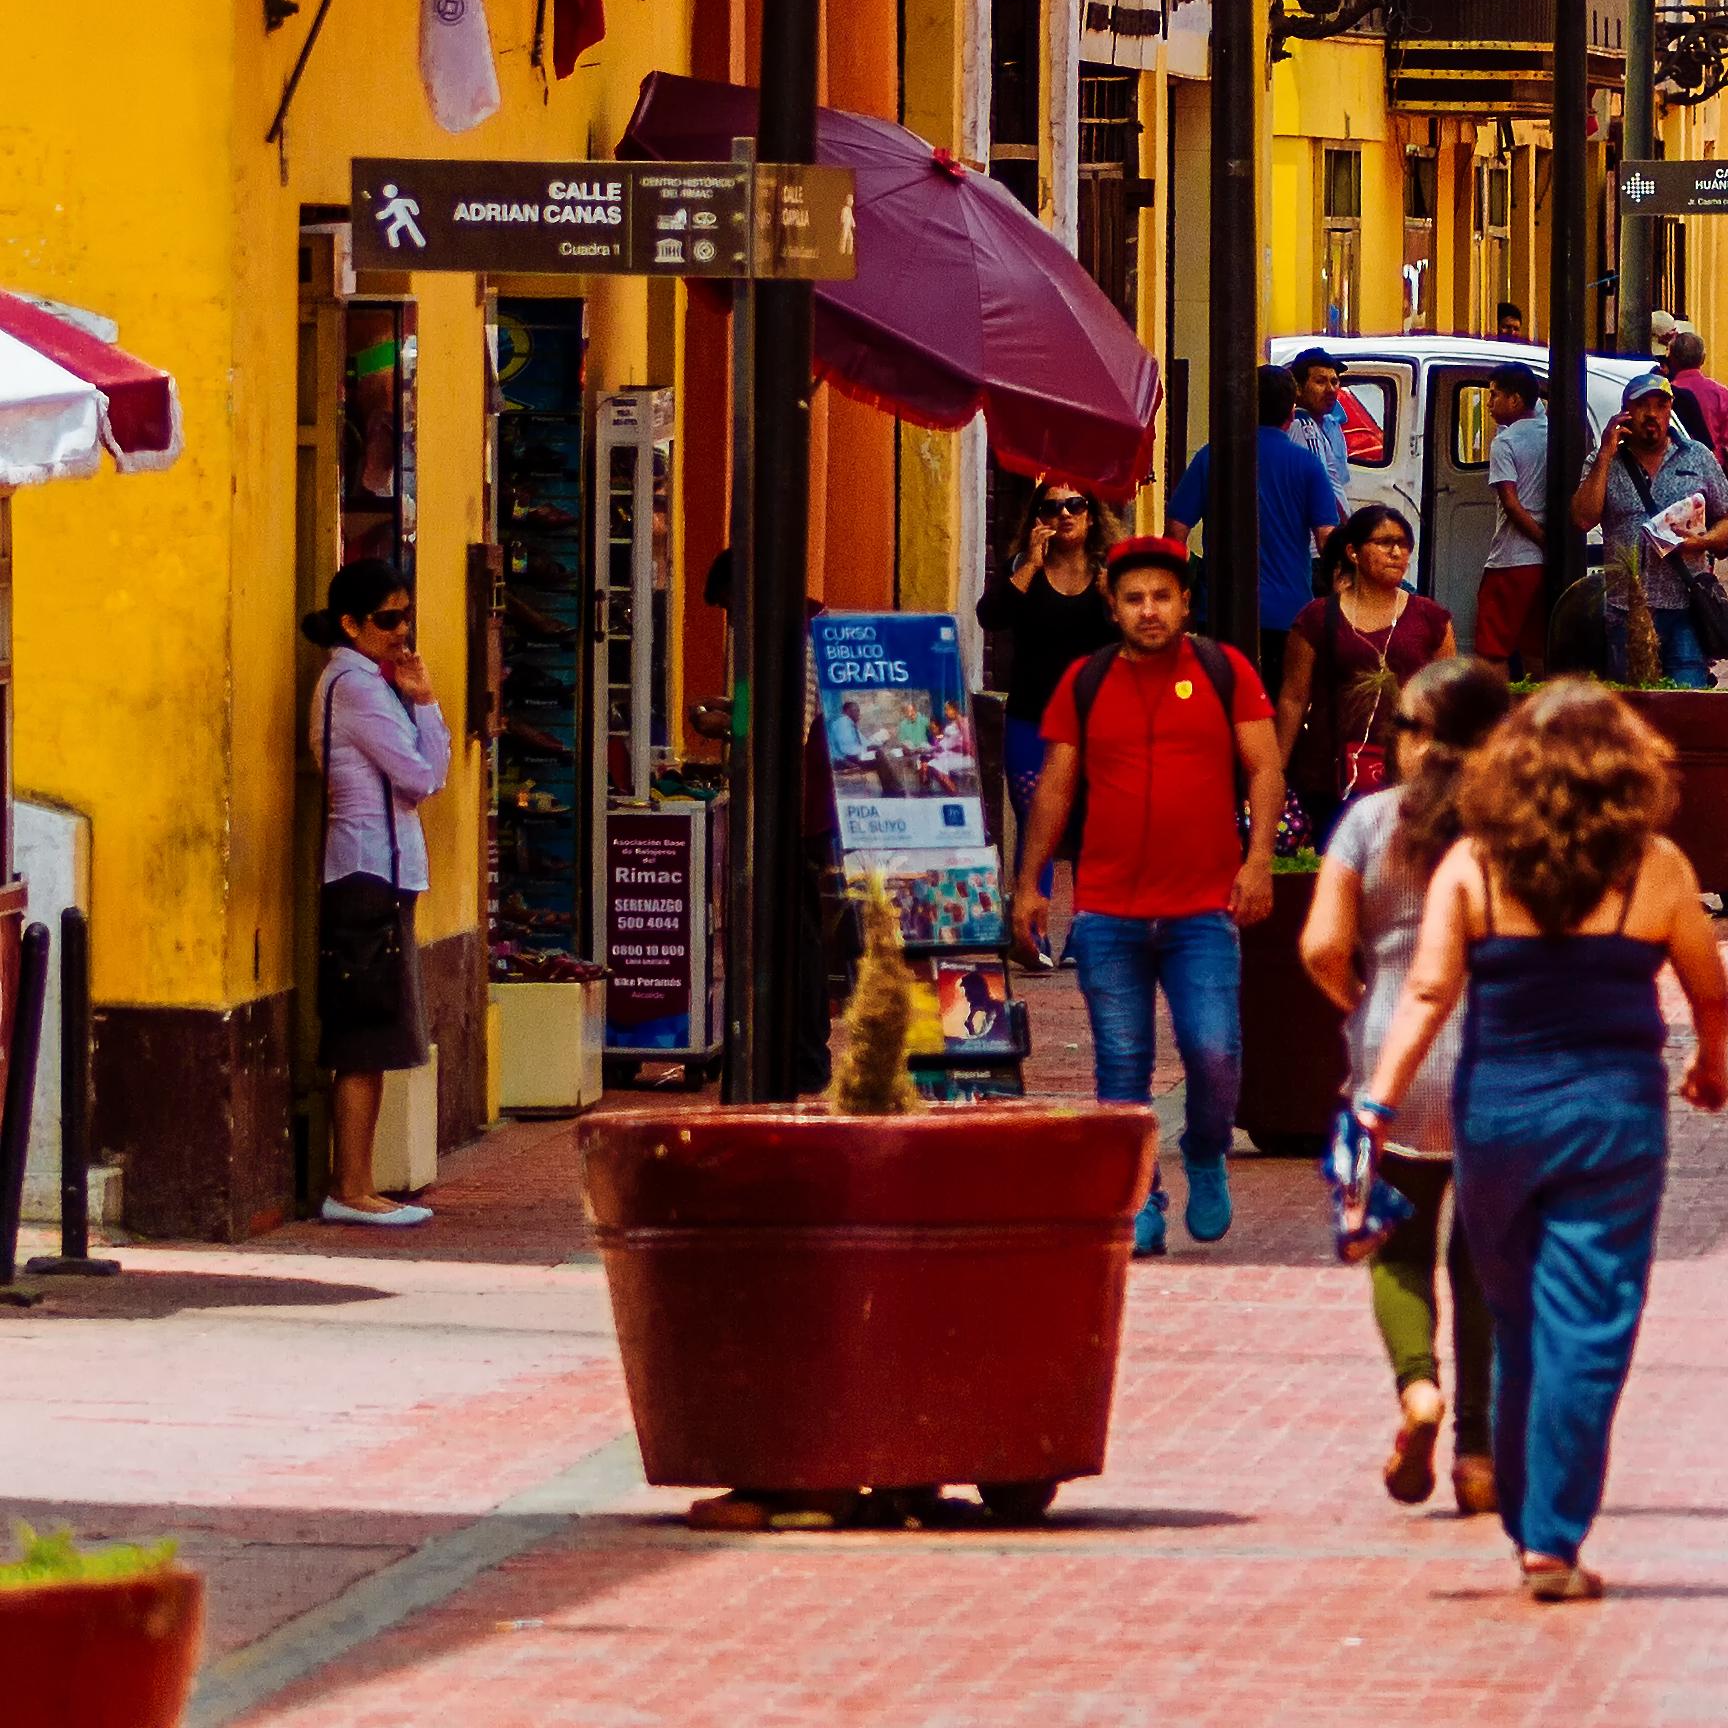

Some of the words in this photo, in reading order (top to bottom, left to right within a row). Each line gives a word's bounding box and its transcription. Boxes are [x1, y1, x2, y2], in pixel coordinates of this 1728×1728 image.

[548, 182, 622, 201] CALLE
[453, 202, 540, 222] ADRIAN
[543, 204, 622, 225] CANAS
[559, 242, 611, 256] Cuadra
[613, 243, 620, 255] 1
[823, 626, 877, 641] CURSO
[827, 660, 909, 684] GRATIS
[847, 805, 880, 818] PIDA
[849, 820, 866, 834] EL
[869, 819, 906, 833] SUYO
[615, 866, 682, 884] Rimac
[614, 898, 683, 913] SERENAZGO
[617, 916, 644, 929] 500
[646, 917, 679, 929] 4044
